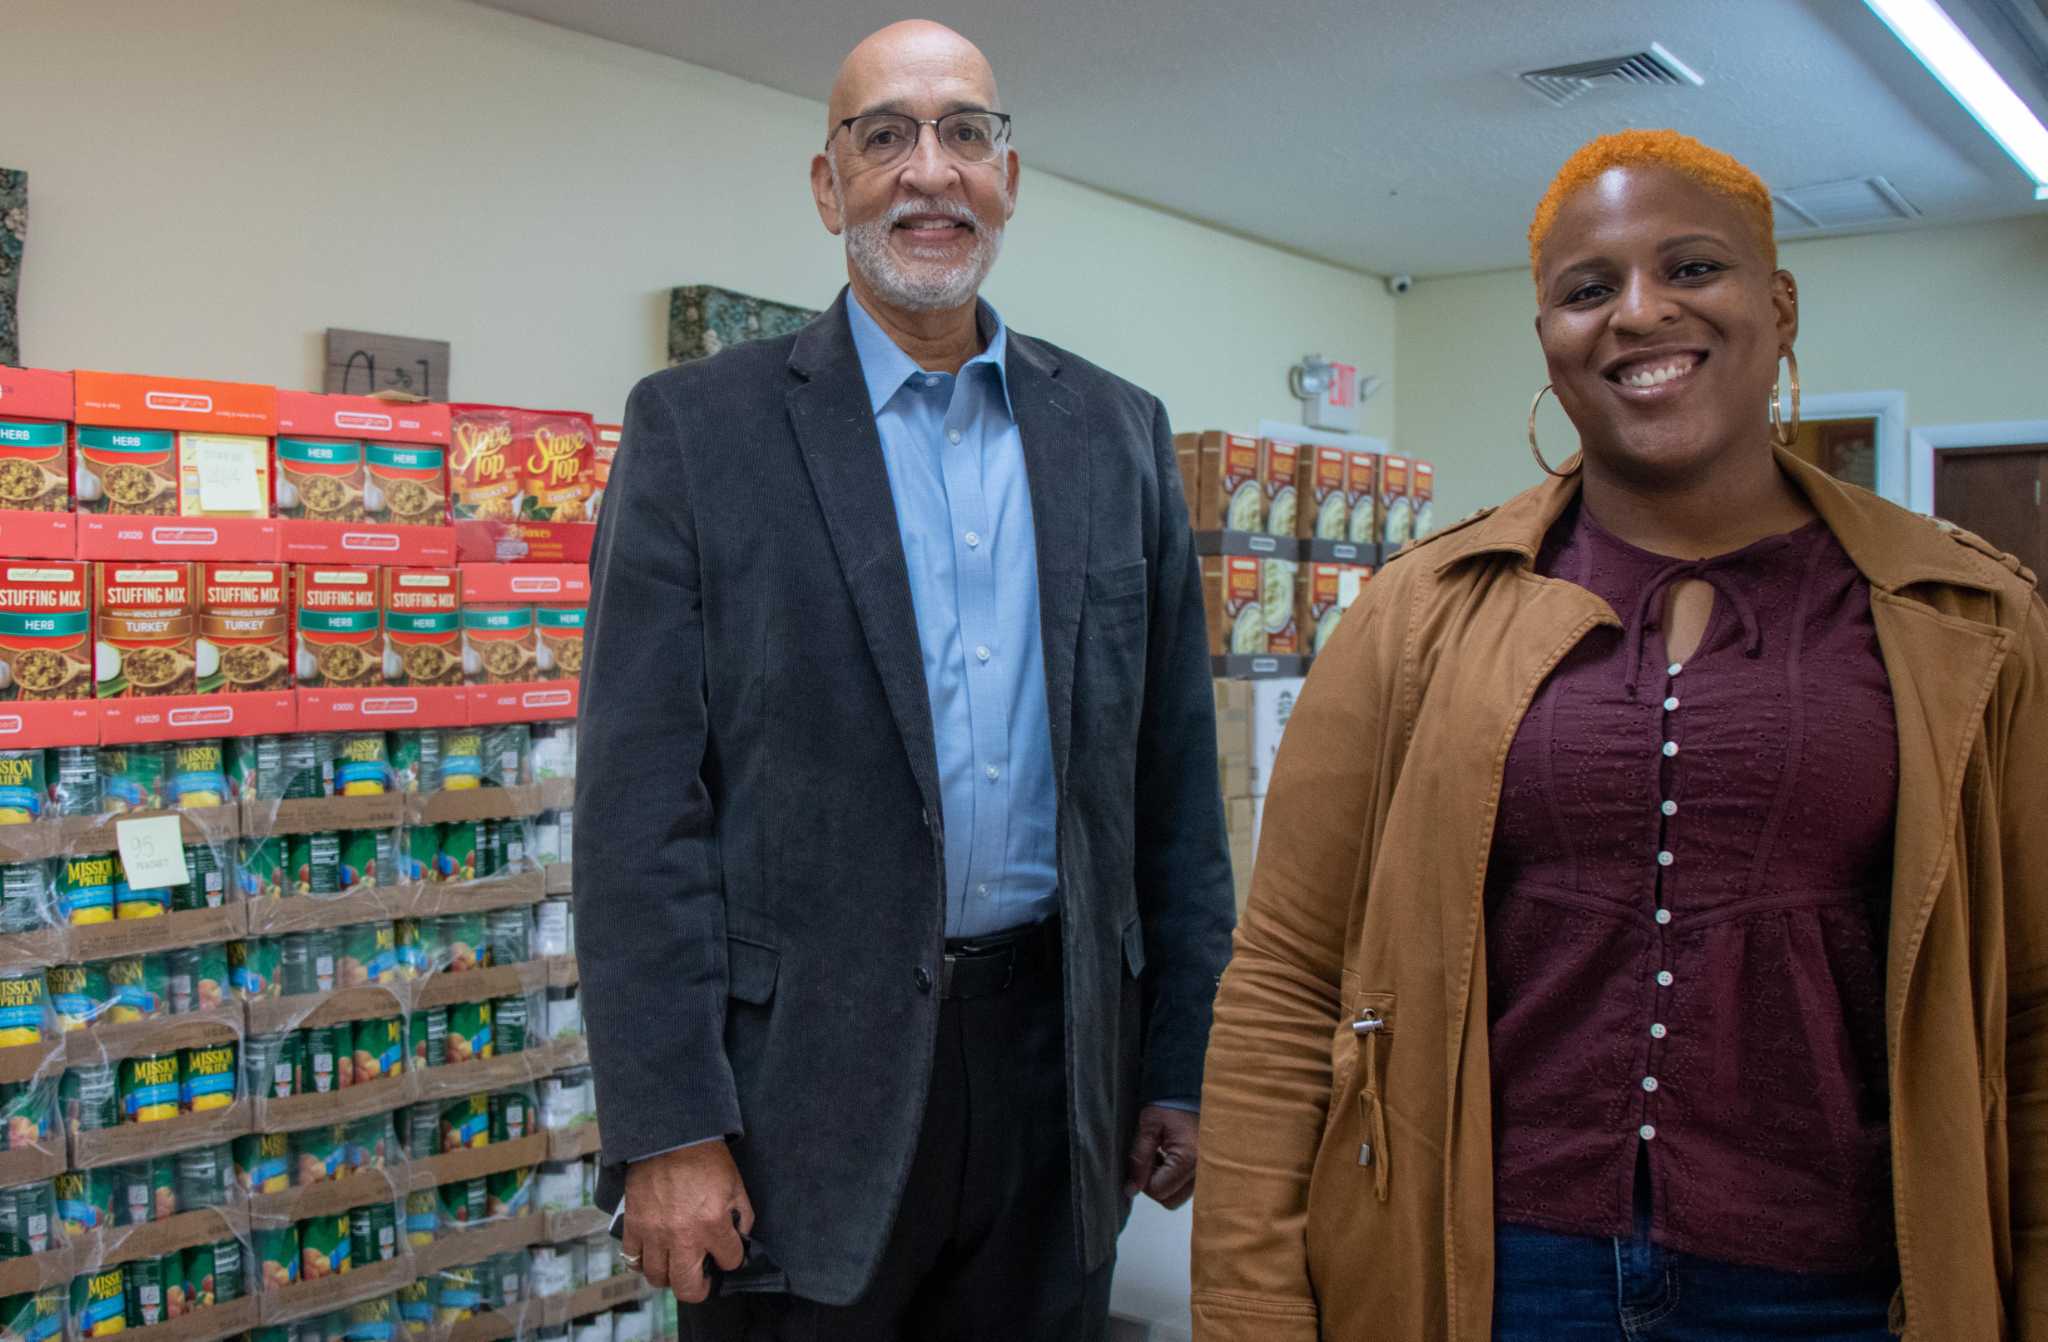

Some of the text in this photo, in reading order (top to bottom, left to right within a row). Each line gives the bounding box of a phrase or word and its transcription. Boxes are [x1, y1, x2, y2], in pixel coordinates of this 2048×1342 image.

[0, 430, 30, 441] HERB
[113, 435, 141, 447] HERB
[451, 423, 512, 468] Stove
[528, 428, 585, 474] Stove
[308, 448, 333, 458] HERB
[393, 454, 417, 464] HERB
[475, 453, 505, 481] Top
[551, 457, 580, 485] Top
[0, 589, 81, 607] STUFFING MIX
[108, 587, 186, 604] STUFFING MIX
[208, 587, 280, 603] STUFFING MIX
[307, 590, 373, 606] STUFFING MIX
[393, 592, 455, 607] STUFFING MIX
[25, 619, 55, 631] HERB
[328, 617, 353, 627] HERB
[413, 618, 435, 628] HERB
[488, 616, 509, 625] HERB
[560, 614, 580, 624] HERB
[126, 621, 170, 633] TURKEY
[224, 620, 264, 631] TURKEY
